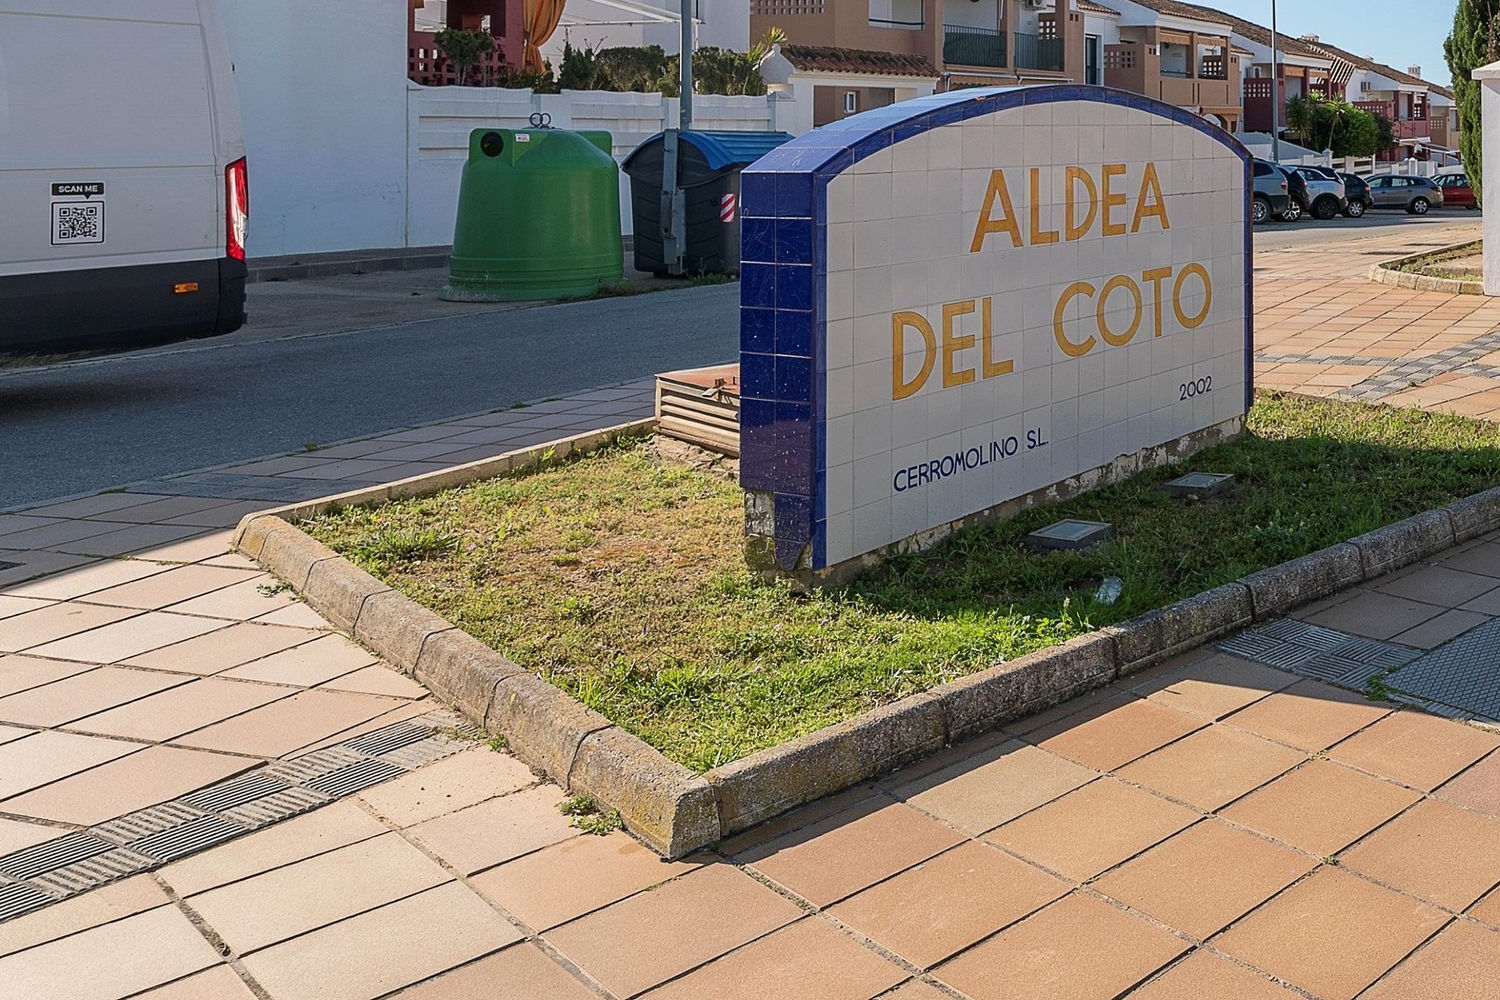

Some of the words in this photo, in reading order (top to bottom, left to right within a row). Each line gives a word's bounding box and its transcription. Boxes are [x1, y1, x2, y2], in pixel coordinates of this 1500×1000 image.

[58, 185, 83, 193] SCAN
[84, 184, 98, 193] ME
[970, 162, 1169, 253] ALDEA
[892, 297, 1014, 401] DEL
[1053, 262, 1212, 357] COTO
[1179, 375, 1212, 401] 2002
[893, 436, 1018, 492] CERROMOLINO
[1026, 427, 1050, 450] S.L.
